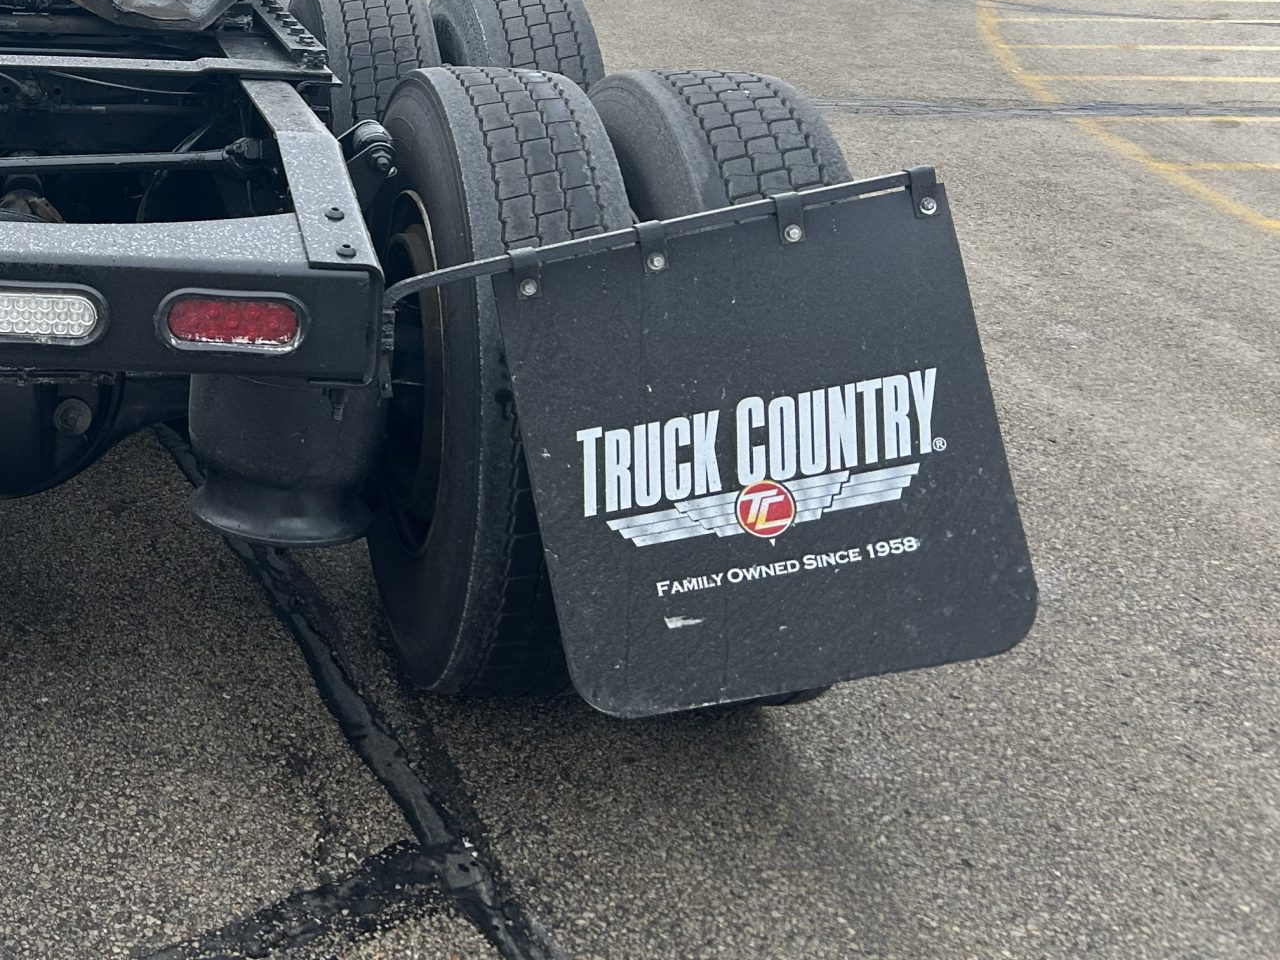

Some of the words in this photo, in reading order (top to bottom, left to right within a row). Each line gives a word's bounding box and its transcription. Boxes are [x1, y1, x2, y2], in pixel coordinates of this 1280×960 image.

[576, 409, 722, 518] TRUCK
[736, 367, 937, 486] COUNTRY
[656, 572, 723, 597] FAMILY
[727, 558, 800, 584] OWNED
[802, 548, 862, 570] SINCE
[866, 536, 919, 560] 1958
